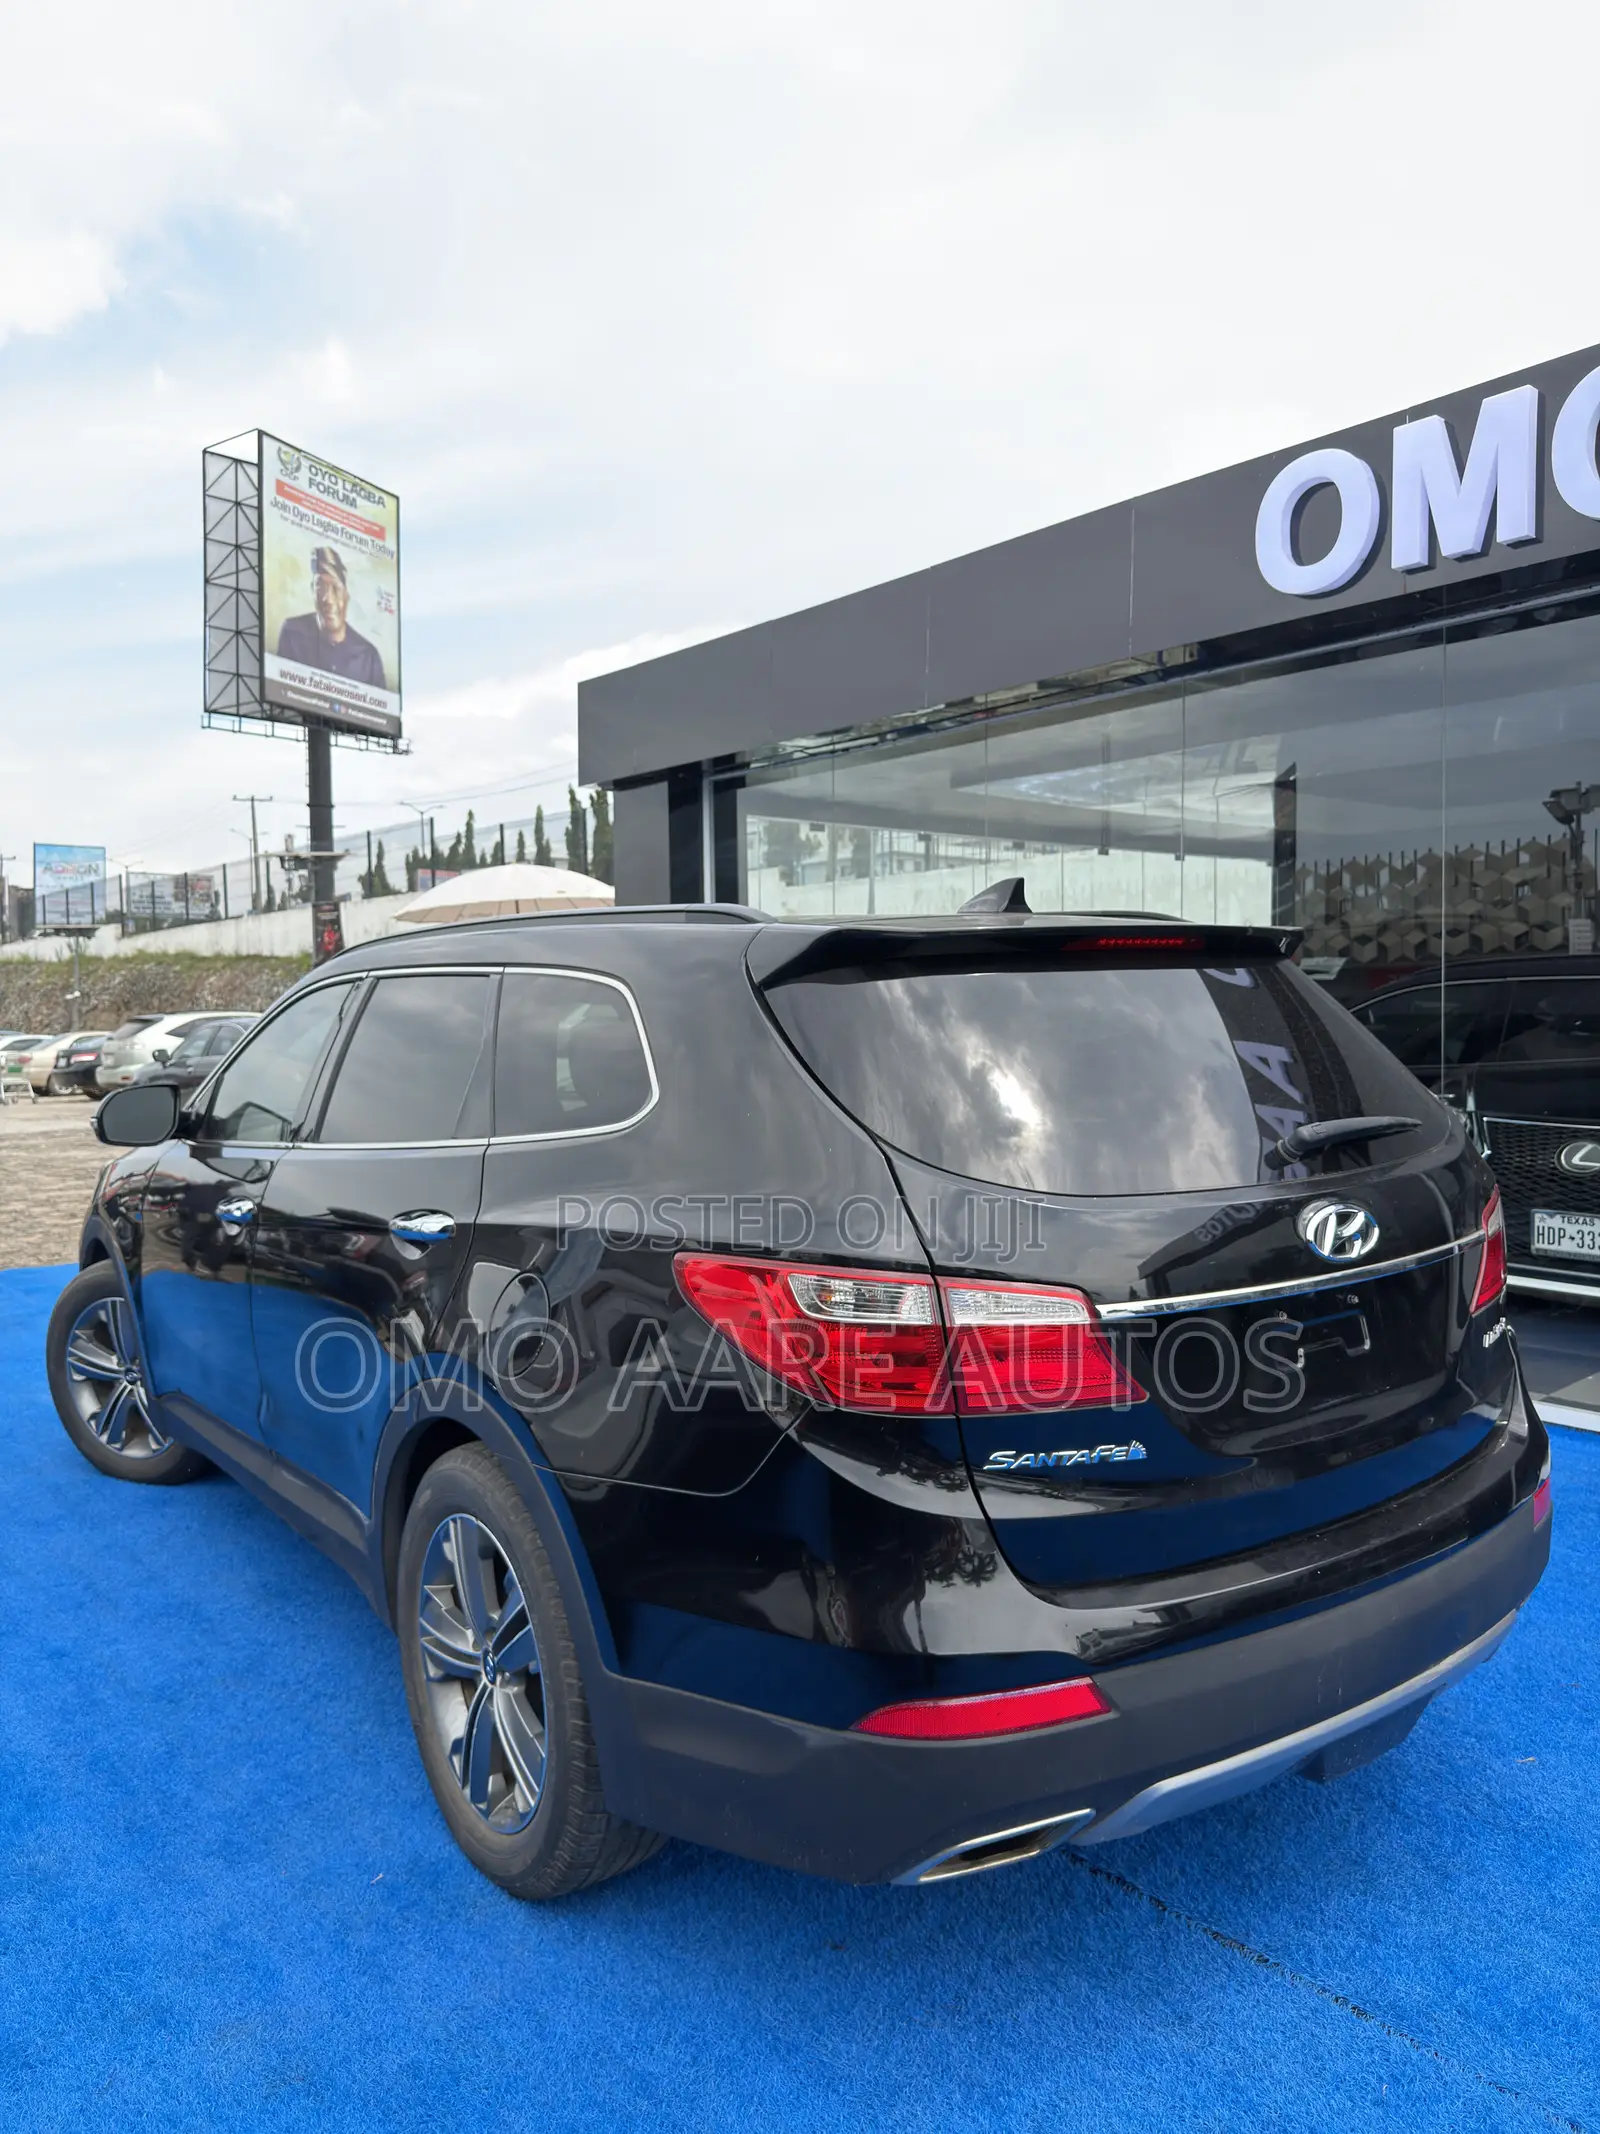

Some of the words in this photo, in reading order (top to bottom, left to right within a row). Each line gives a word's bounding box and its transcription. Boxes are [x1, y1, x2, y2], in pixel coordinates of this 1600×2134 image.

[308, 463, 338, 486] OYO
[342, 480, 386, 508] LAGBA
[308, 477, 358, 509] FORUM
[270, 496, 292, 514] Join
[292, 504, 311, 523] Oyo
[340, 527, 370, 547] Forum
[370, 538, 395, 559] Today
[1560, 1215, 1595, 1227] TEXAS
